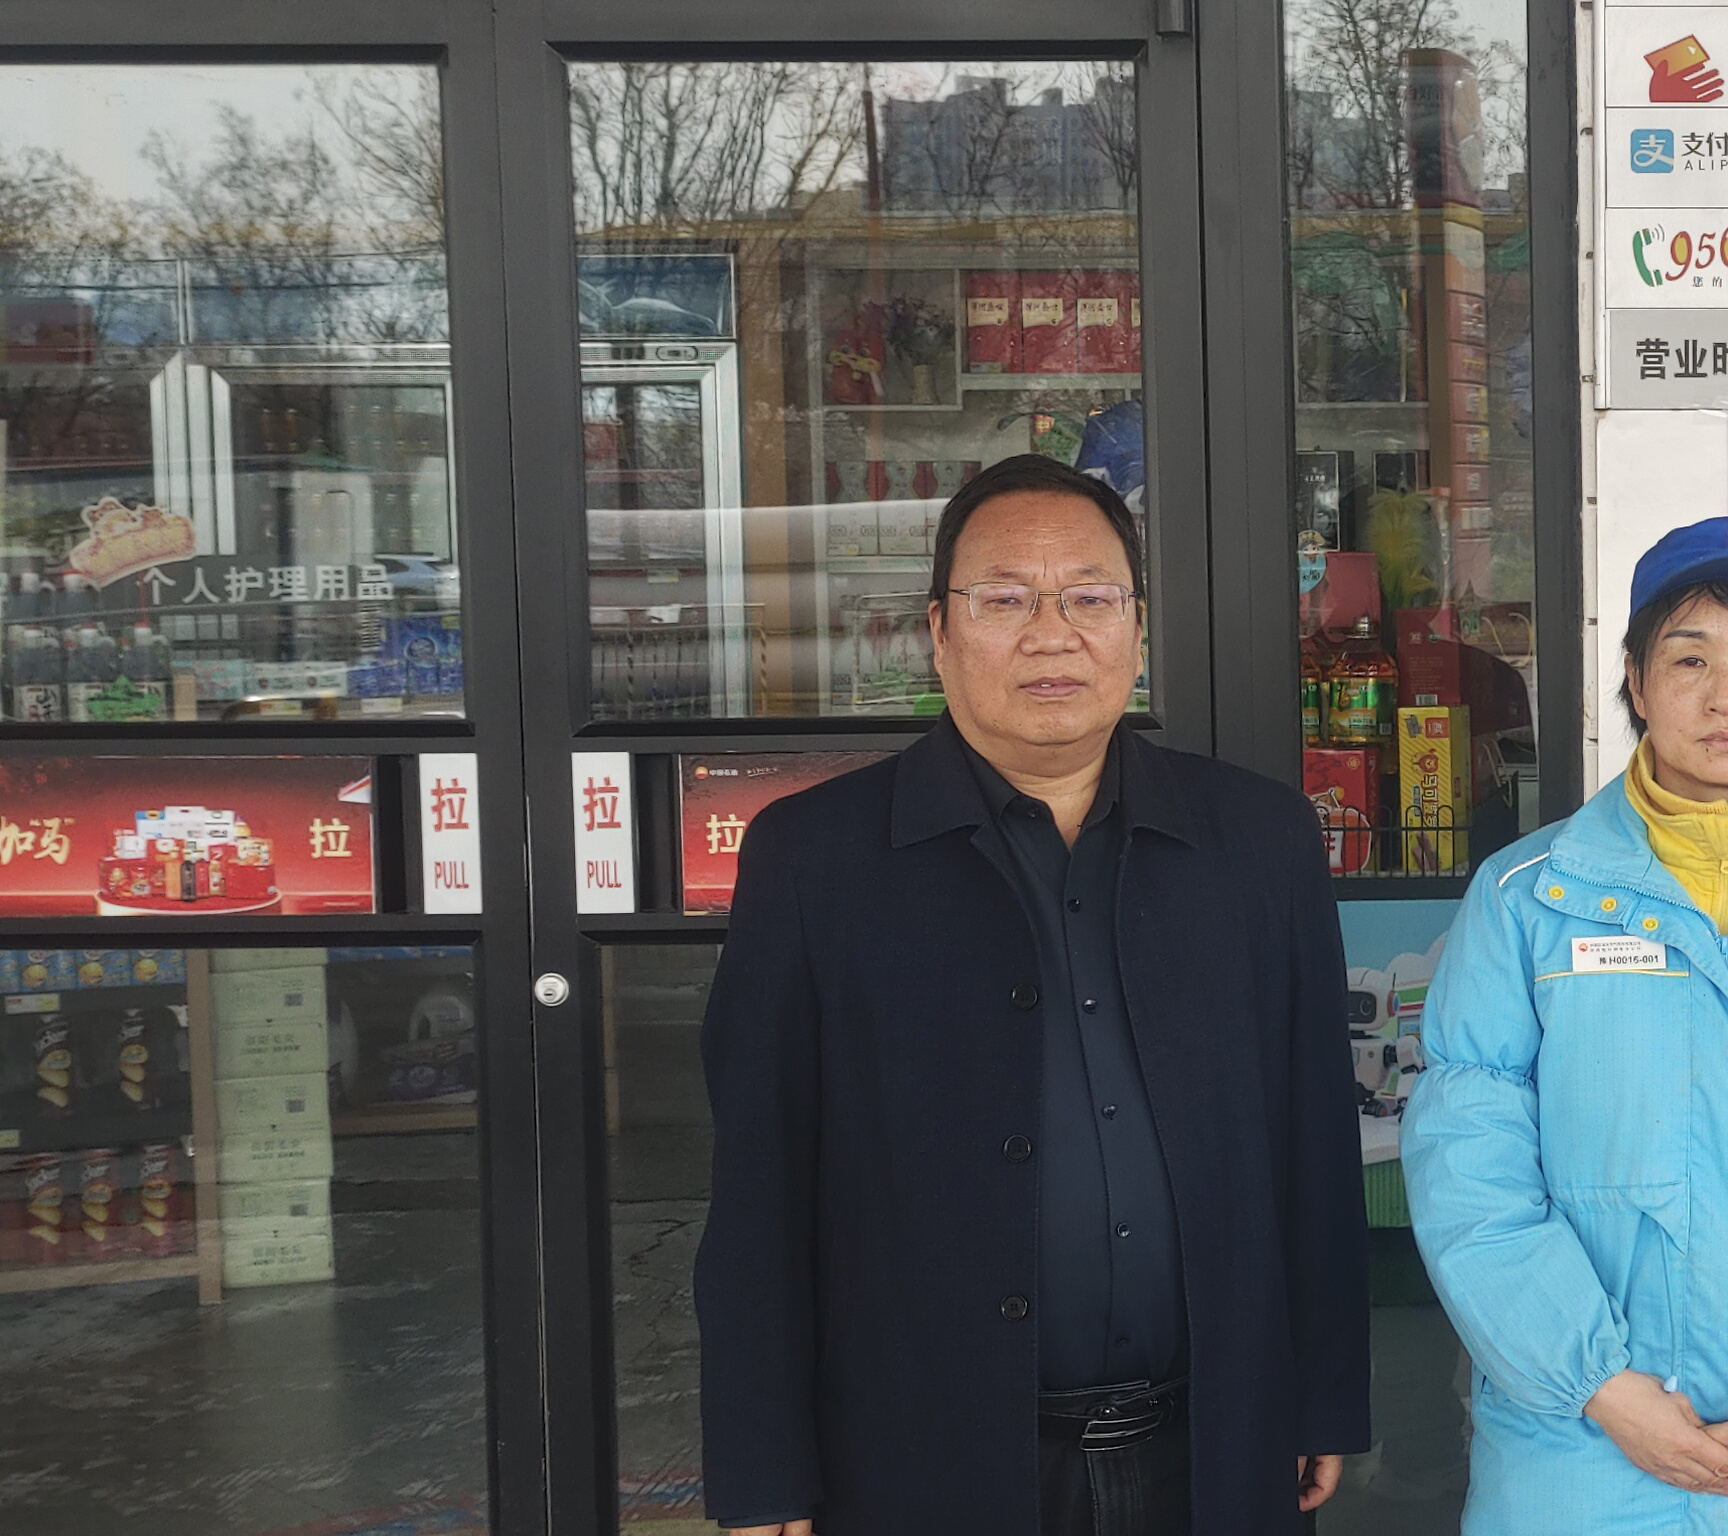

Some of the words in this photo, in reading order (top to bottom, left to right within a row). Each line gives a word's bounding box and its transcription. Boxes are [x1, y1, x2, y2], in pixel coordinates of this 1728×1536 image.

[142, 565, 393, 606] 个人护理用品
[430, 775, 469, 832] 拉
[582, 776, 622, 832] 拉
[309, 817, 352, 859] 拉
[705, 813, 746, 854] 拉
[434, 861, 470, 889] PULL
[586, 860, 622, 889] PULL
